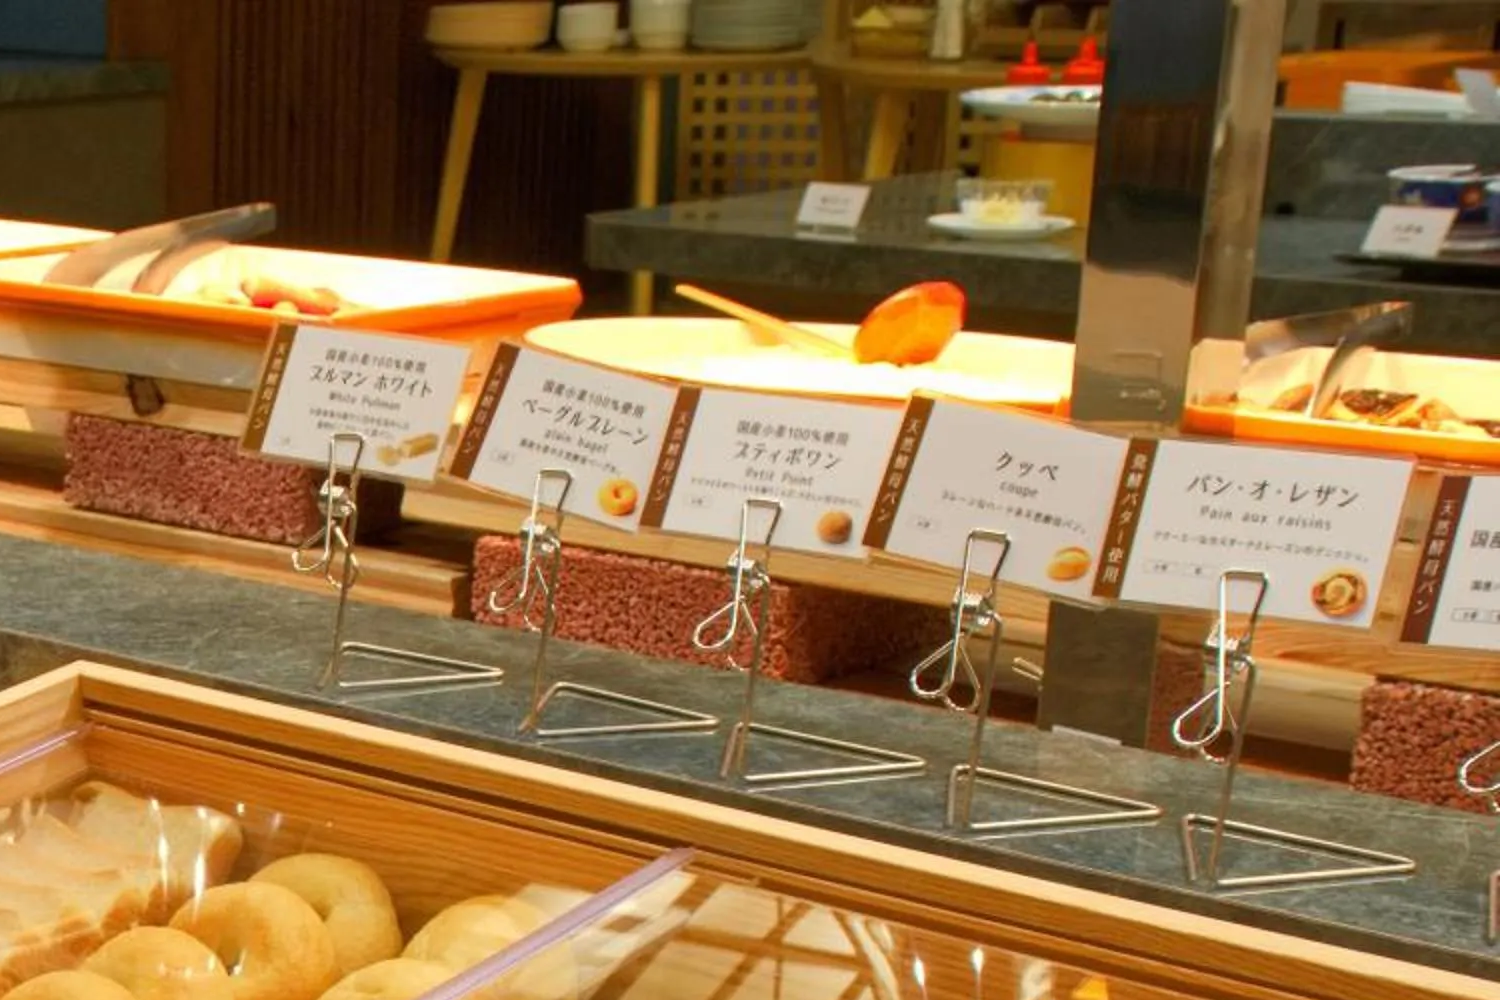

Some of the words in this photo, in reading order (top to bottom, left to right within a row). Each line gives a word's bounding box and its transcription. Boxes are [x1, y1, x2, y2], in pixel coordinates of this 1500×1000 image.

[373, 374, 434, 398] ホワイト
[736, 420, 850, 447] 国産小麦100%使用
[996, 451, 1060, 482] クッペ
[1186, 474, 1360, 508] パン・オ・レザン
[1200, 505, 1234, 521] Pain
[1242, 511, 1269, 525] aux
[1277, 514, 1333, 532] raisins
